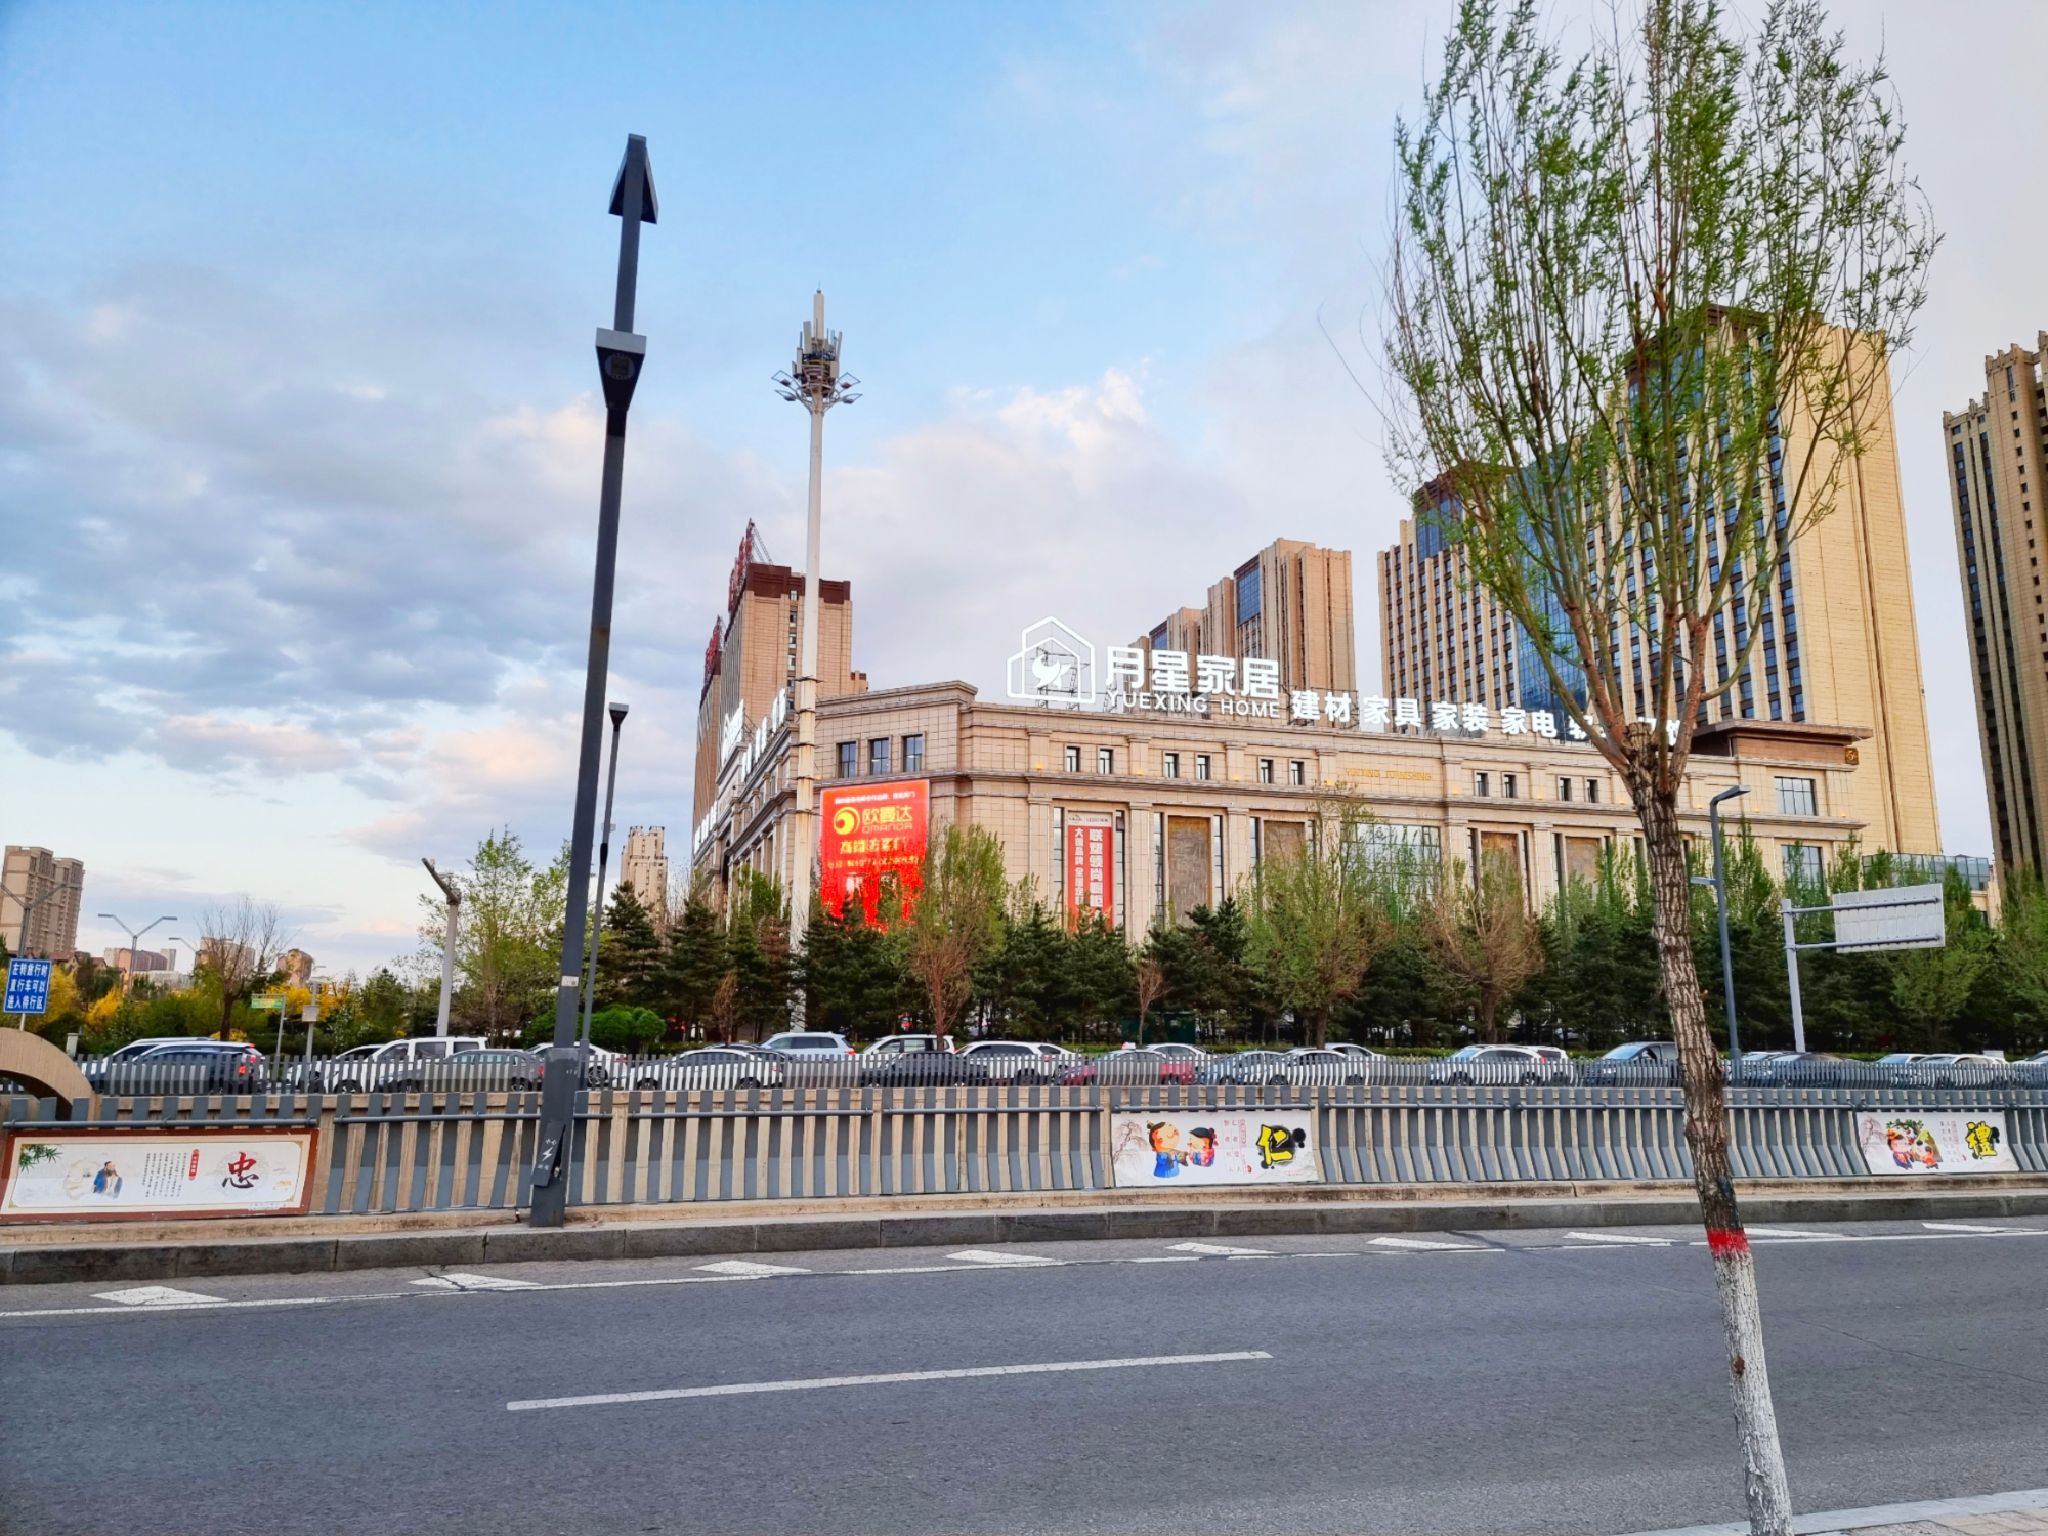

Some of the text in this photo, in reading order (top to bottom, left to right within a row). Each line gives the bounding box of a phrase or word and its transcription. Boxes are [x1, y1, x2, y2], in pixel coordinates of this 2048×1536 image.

[1105, 646, 1280, 699] 月星家居
[1107, 690, 1281, 719] YUEXING HOME
[1291, 689, 1352, 723] 建材
[1362, 693, 1421, 728] 家具
[1431, 702, 1490, 733] 家装
[1500, 706, 1557, 739] 家电
[1255, 1123, 1294, 1167] 仁
[222, 1151, 260, 1189] 忠
